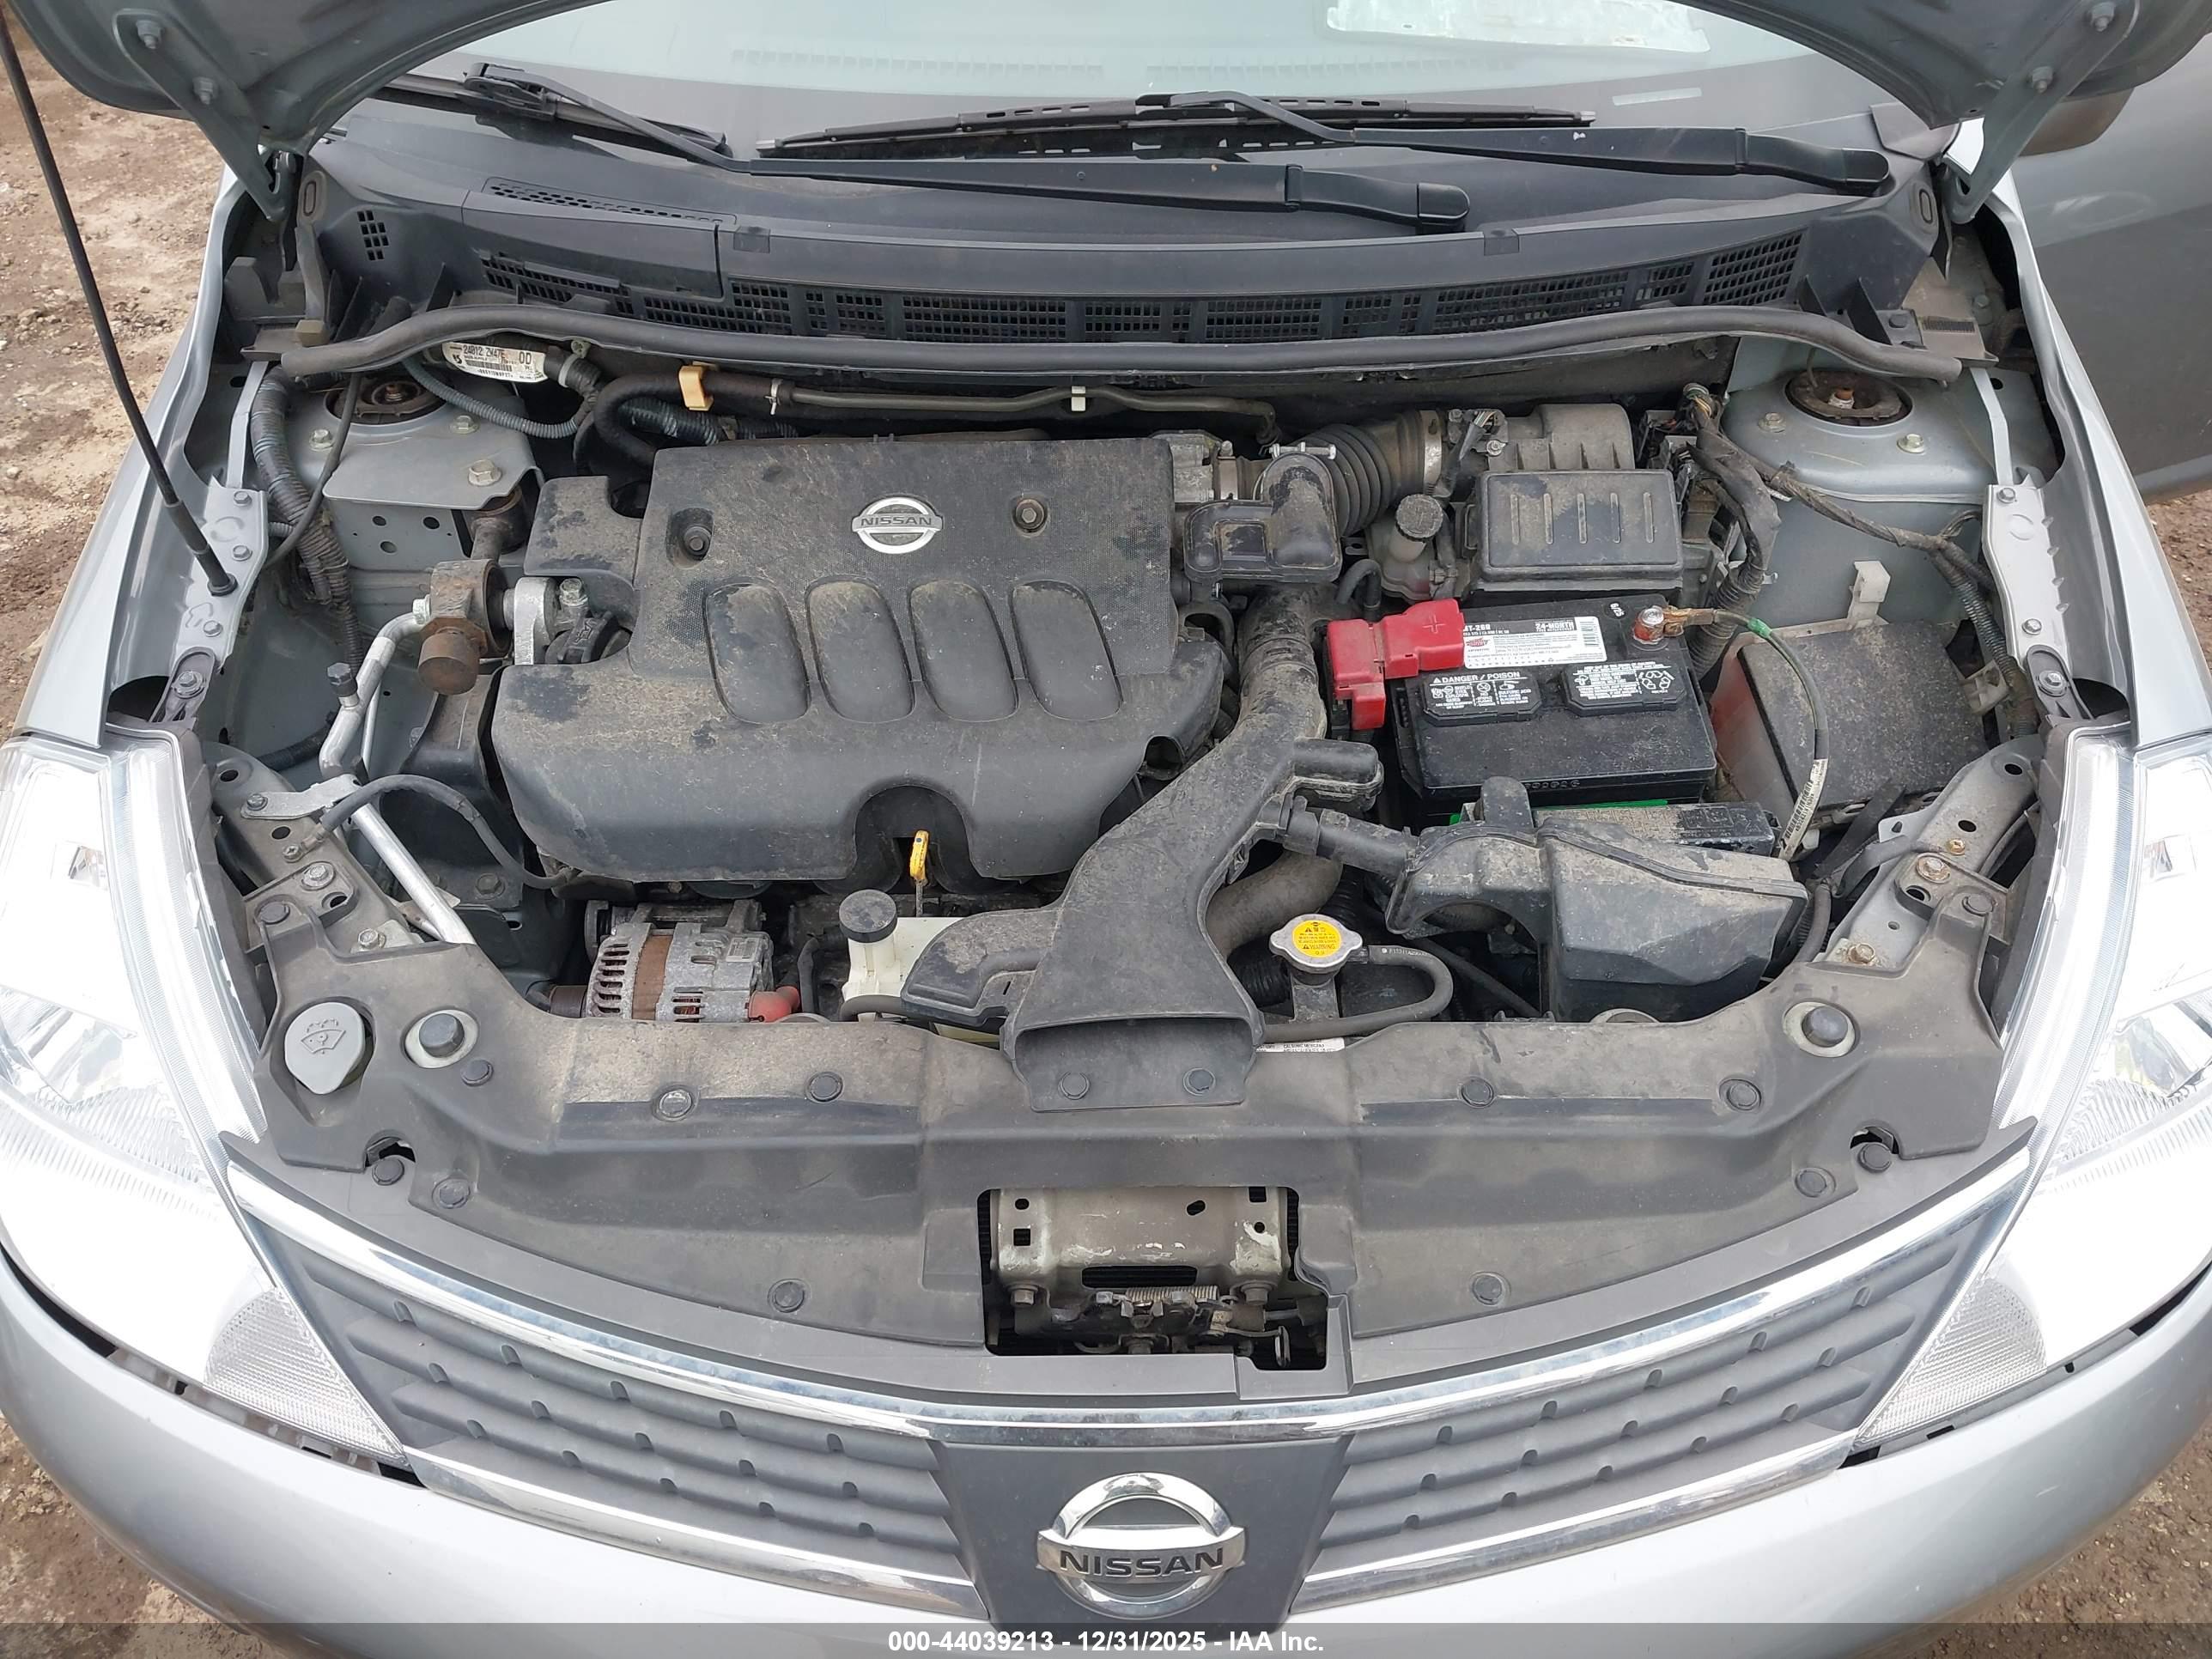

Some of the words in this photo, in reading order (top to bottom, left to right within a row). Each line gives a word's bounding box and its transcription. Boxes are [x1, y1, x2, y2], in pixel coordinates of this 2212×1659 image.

[860, 516, 933, 526] NISSAN
[1610, 603, 1625, 617] 6/25
[1442, 675, 1478, 684] DANGER
[1060, 1547, 1224, 1577] NISSAN
